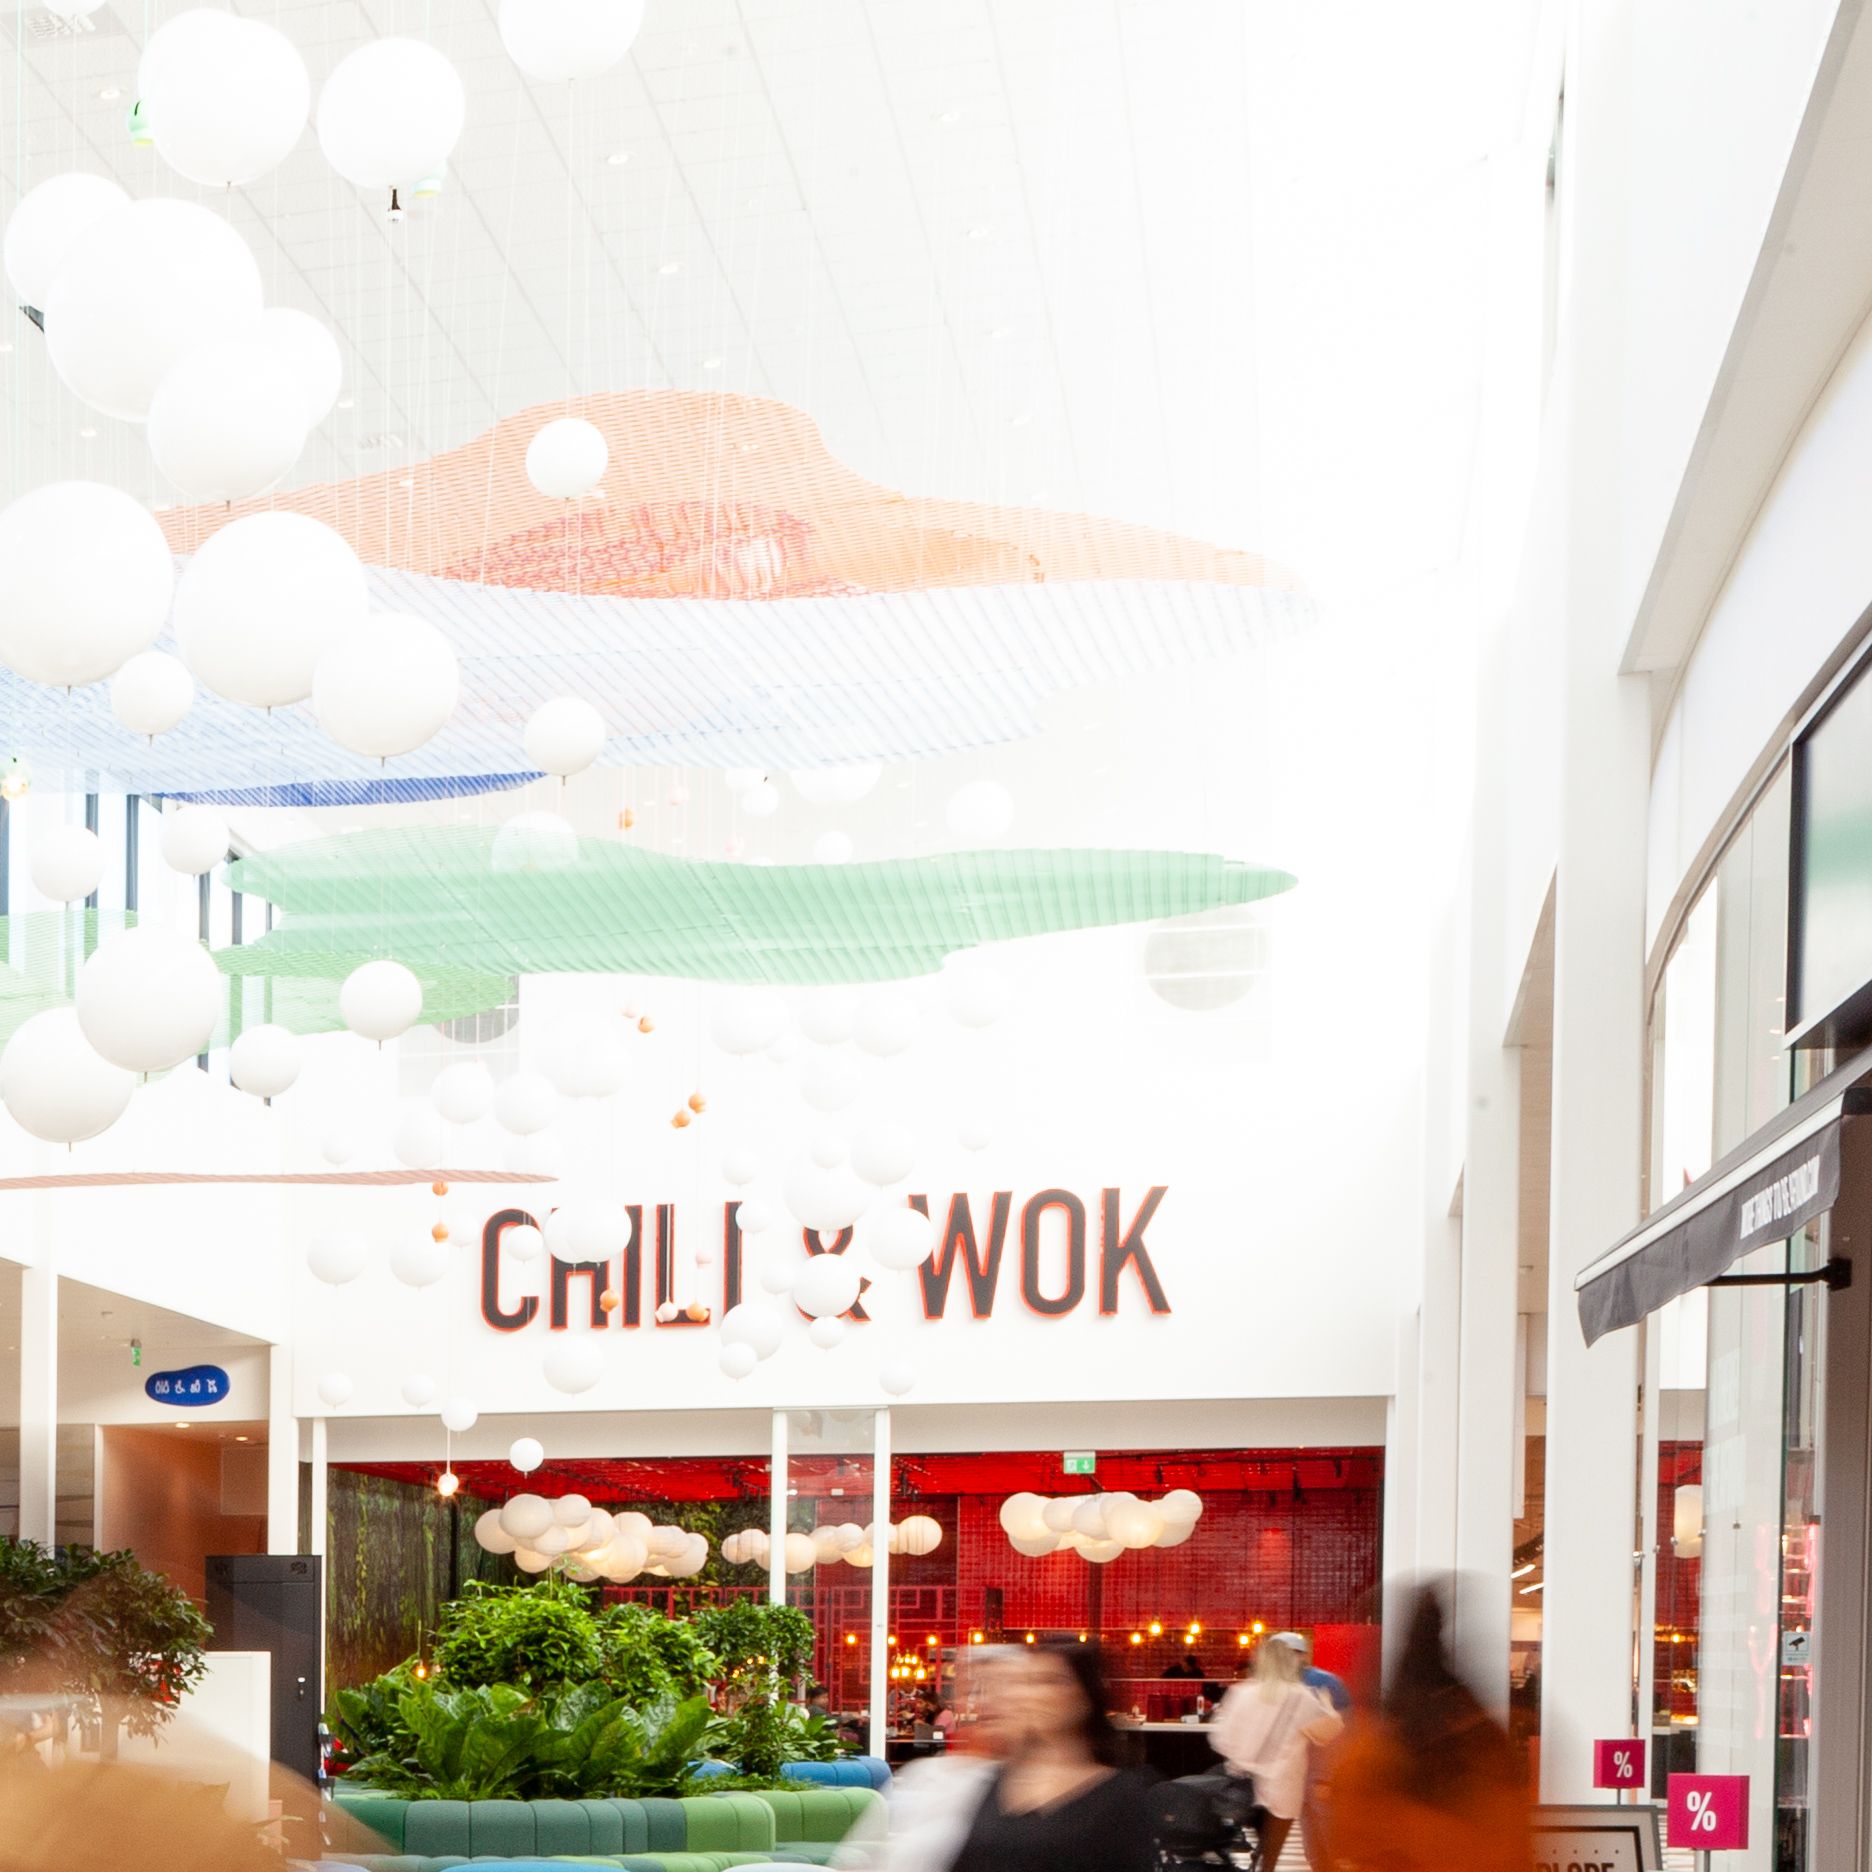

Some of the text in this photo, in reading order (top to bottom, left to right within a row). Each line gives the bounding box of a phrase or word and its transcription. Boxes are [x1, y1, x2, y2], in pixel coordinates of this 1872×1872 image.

[908, 1185, 1172, 1321] WOK
[1613, 1751, 1633, 1779] %
[1686, 1791, 1717, 1832] %
